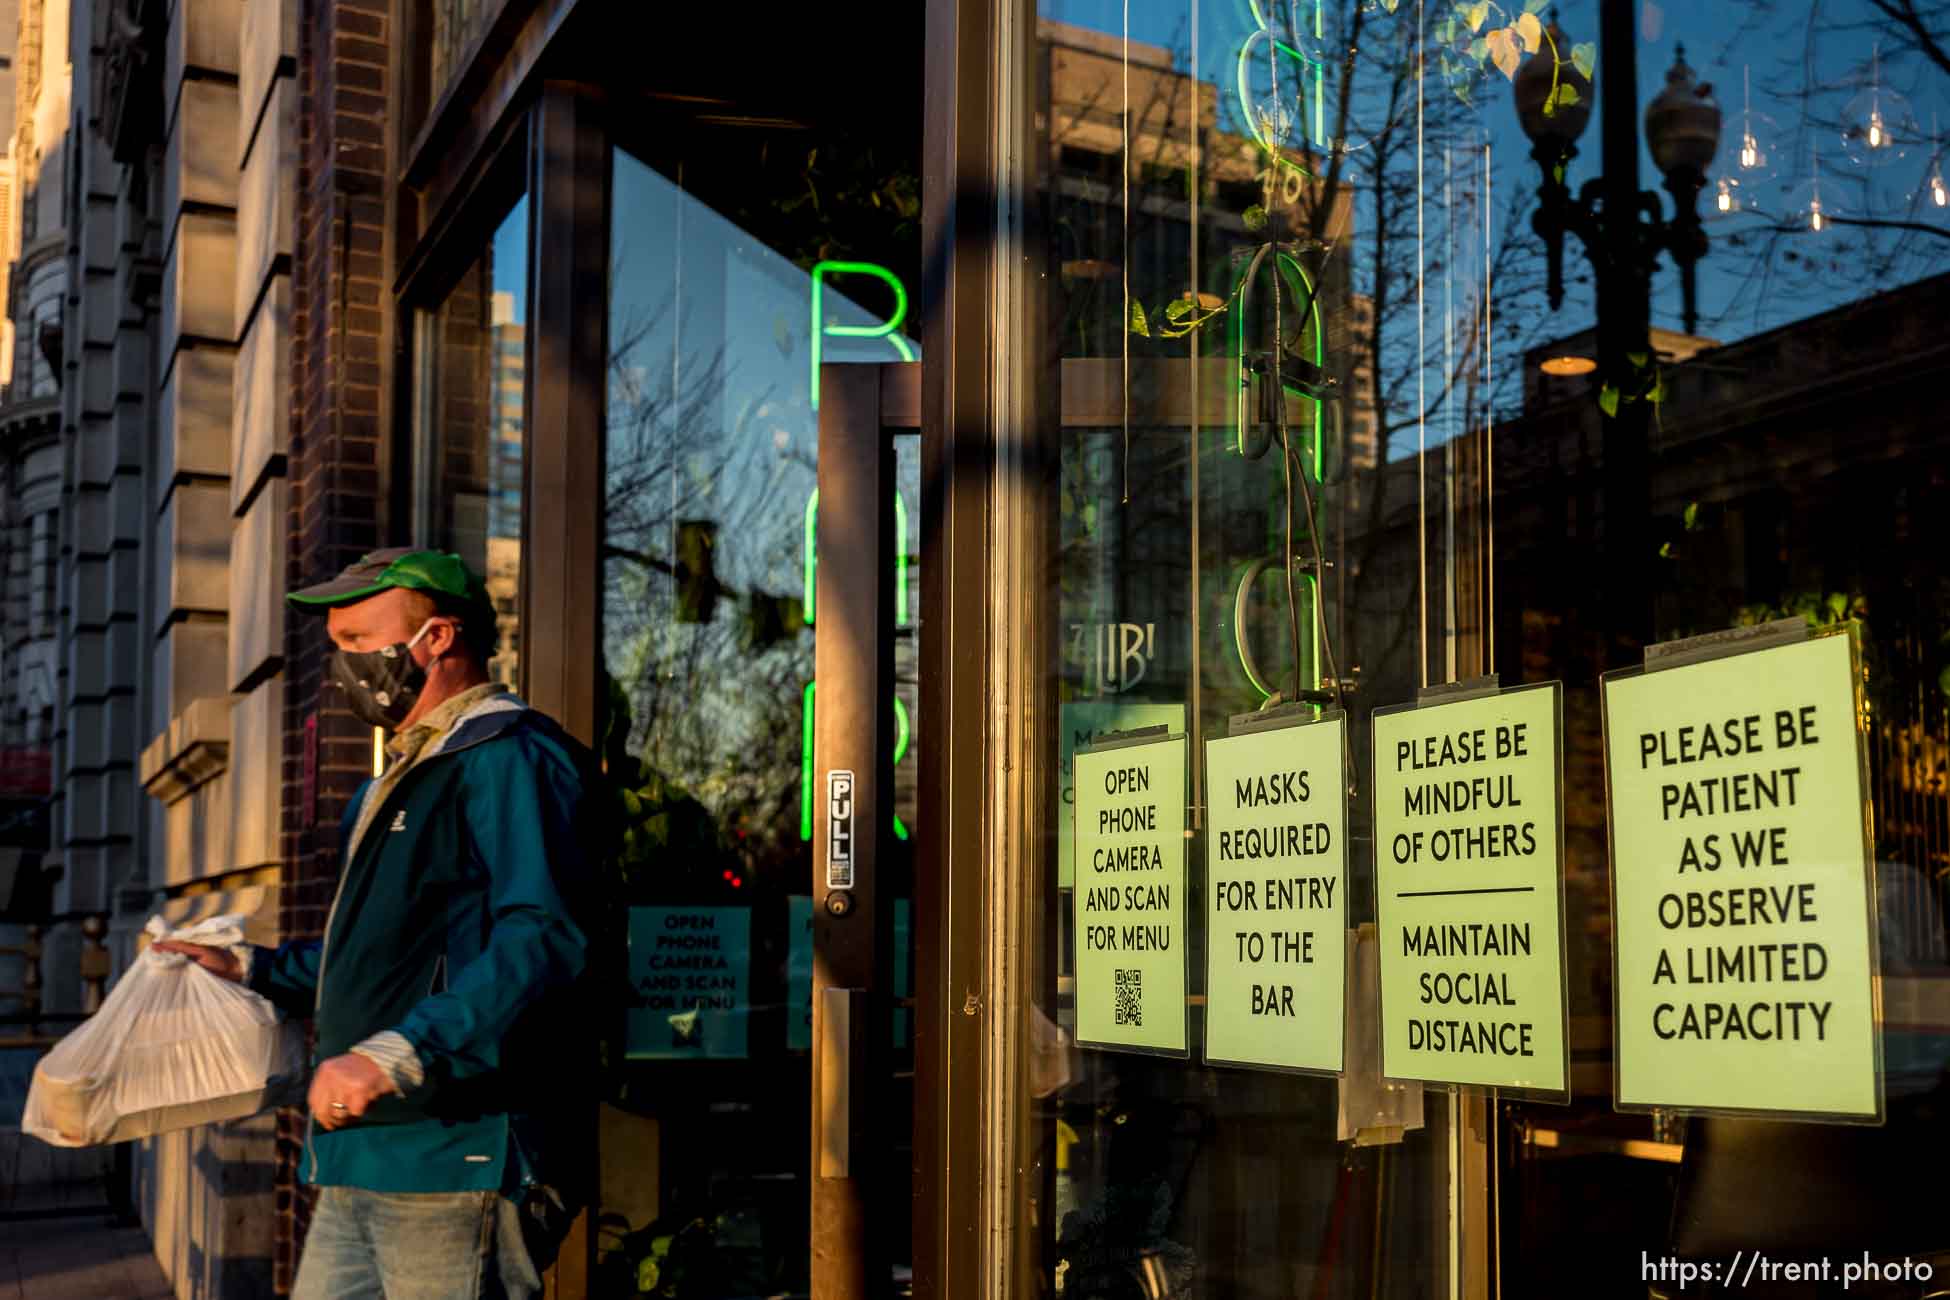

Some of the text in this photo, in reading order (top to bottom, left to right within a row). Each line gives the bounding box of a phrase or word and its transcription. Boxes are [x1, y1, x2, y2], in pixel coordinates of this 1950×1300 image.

[1397, 723, 1528, 772] PLEASE BE
[1639, 705, 1819, 769] PLEASE BE
[1105, 765, 1149, 795] OPEN
[1235, 770, 1311, 809] MASKS
[1404, 774, 1522, 817] MINDFUL
[1661, 767, 1801, 821] PATIENT
[831, 780, 851, 860] PULL
[1099, 804, 1156, 835] PHONE
[1093, 844, 1163, 873] CAMERA
[1219, 822, 1331, 861] REQUIRED
[1392, 821, 1537, 865] OF OTHERS
[1678, 827, 1789, 874] AS WE
[1085, 884, 1170, 912] AND SCAN
[1216, 876, 1337, 912] FOR ENTRY
[1658, 883, 1817, 930] OBSERVE
[663, 914, 715, 929] OPEN
[1087, 925, 1170, 951] FOR MENU
[1402, 922, 1531, 957] MAINTAIN
[656, 935, 721, 949] PHONE
[1235, 931, 1314, 964] TO THE
[648, 954, 728, 969] CAMERA
[1652, 942, 1828, 985] A LIMITED
[639, 975, 736, 990] AND SCAN
[1251, 984, 1296, 1017] BAR
[1419, 972, 1517, 1006] SOCIAL
[1408, 1019, 1534, 1057] DISTANCE
[1653, 1001, 1832, 1041] CAPACITY
